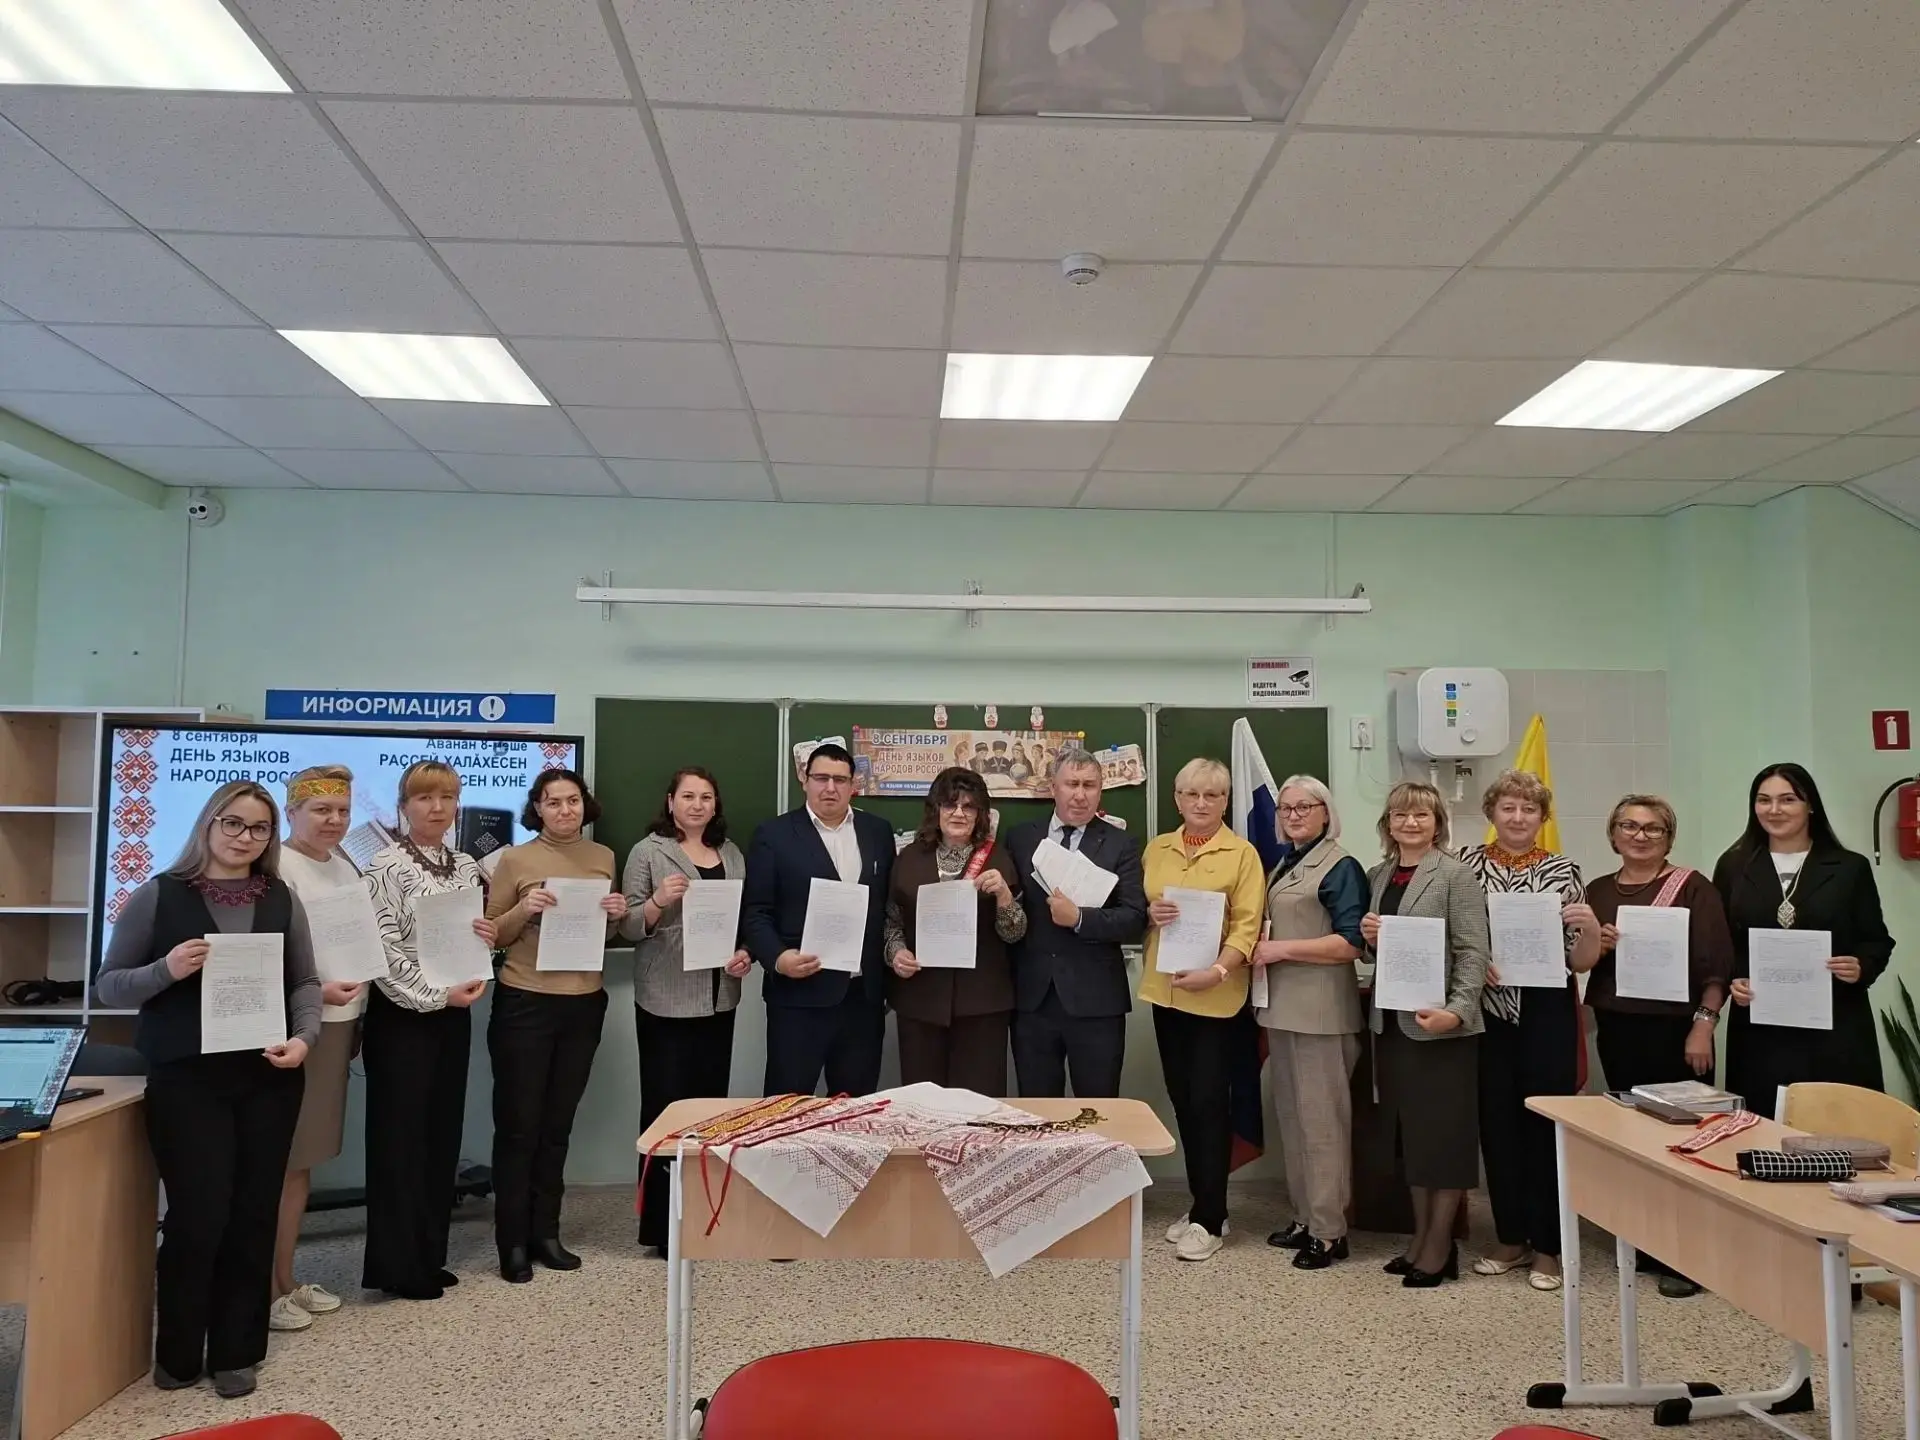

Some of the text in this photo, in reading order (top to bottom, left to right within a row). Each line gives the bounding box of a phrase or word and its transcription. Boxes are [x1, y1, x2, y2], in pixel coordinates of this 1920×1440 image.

[302, 696, 472, 718] ИНФОРМАЦИЯ
[172, 730, 258, 746] 8 сентября
[872, 733, 947, 745] 8 СЕНТЯБРЯ
[170, 748, 290, 763] ДЕНЬ ЯЗЫКОВ
[878, 752, 944, 763] ДЕНЬ ЯЗЫКОВ
[170, 768, 251, 784] НАРОДОВ
[873, 764, 913, 774] НАРОДОВ
